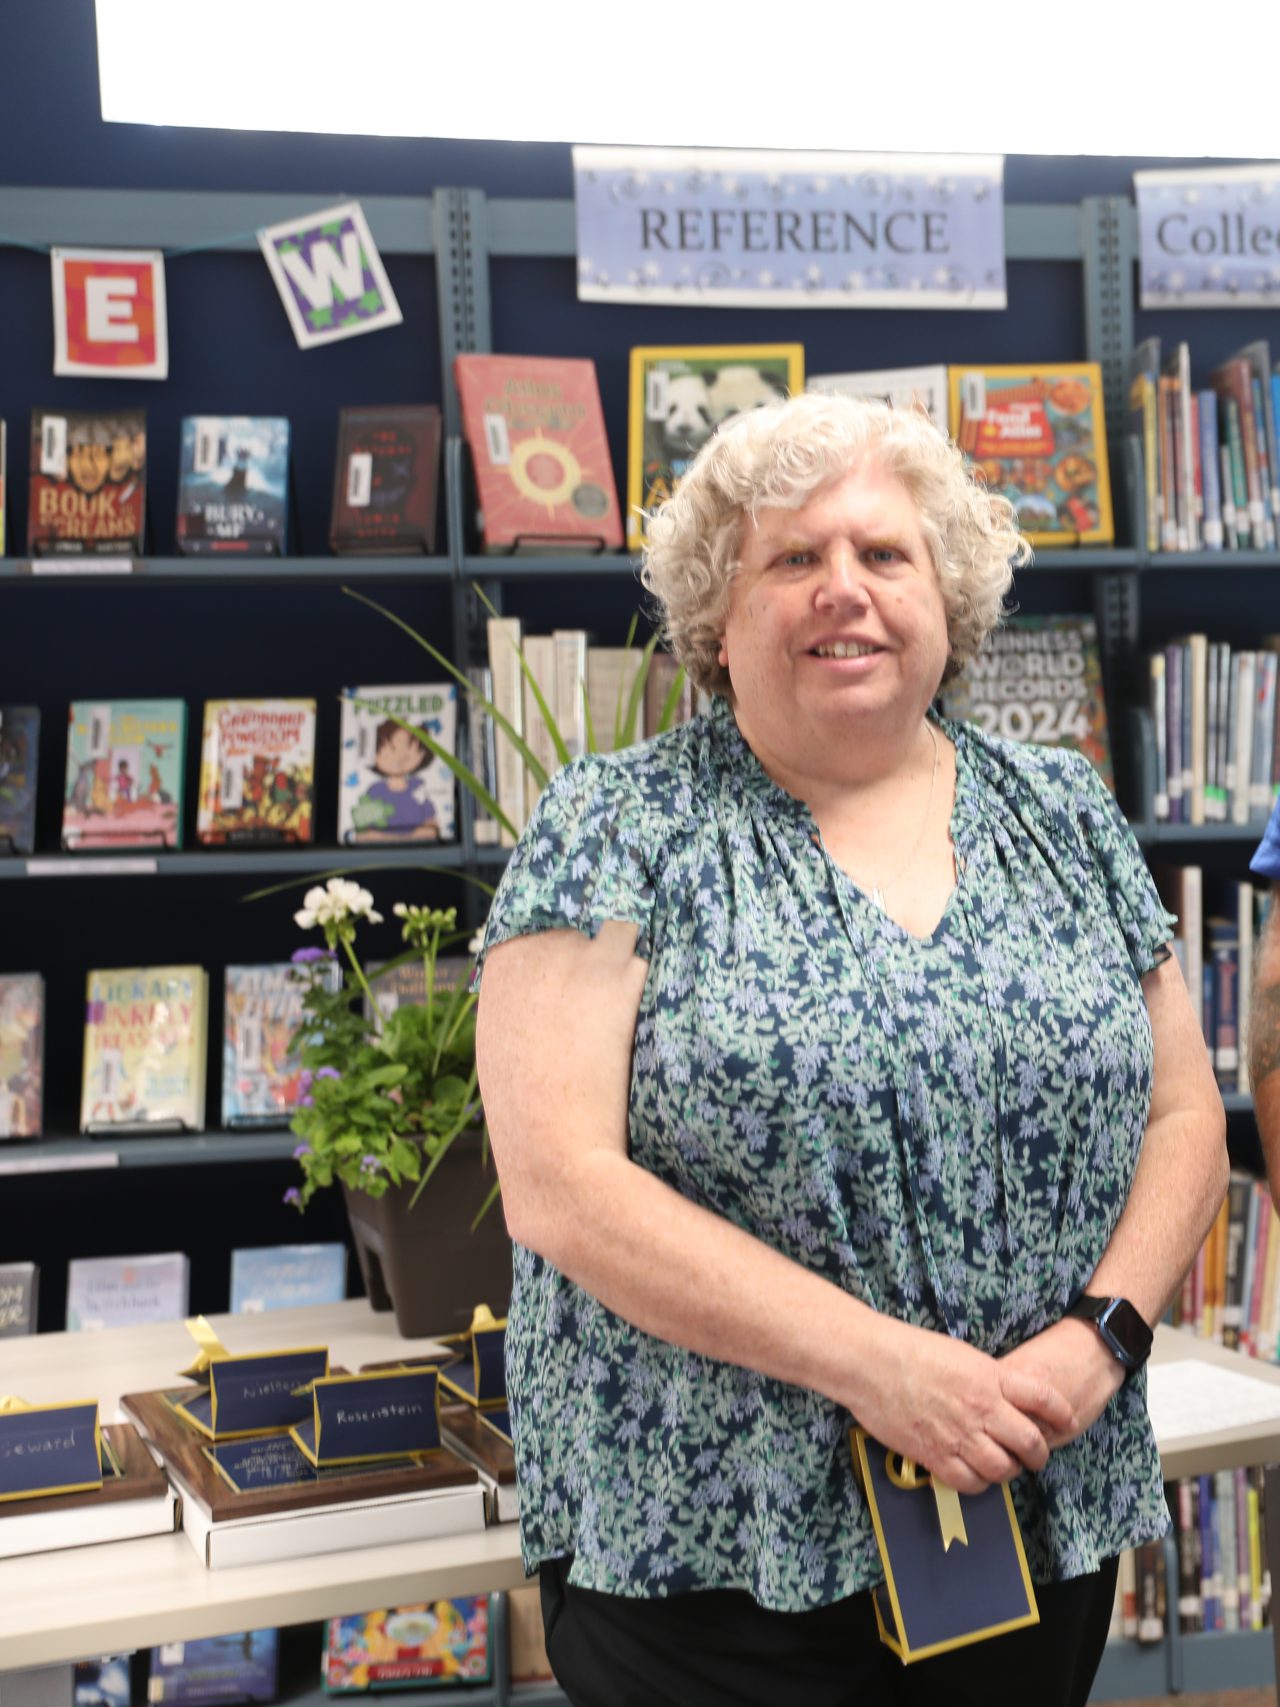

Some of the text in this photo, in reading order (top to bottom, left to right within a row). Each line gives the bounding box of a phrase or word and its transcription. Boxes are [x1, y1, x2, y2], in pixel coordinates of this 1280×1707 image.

[640, 208, 950, 254] REFERENCE
[280, 232, 366, 310] W
[86, 276, 139, 342] E
[968, 651, 1085, 678] WORLD
[353, 694, 443, 716] PUZZLED
[974, 699, 1091, 741] 2024
